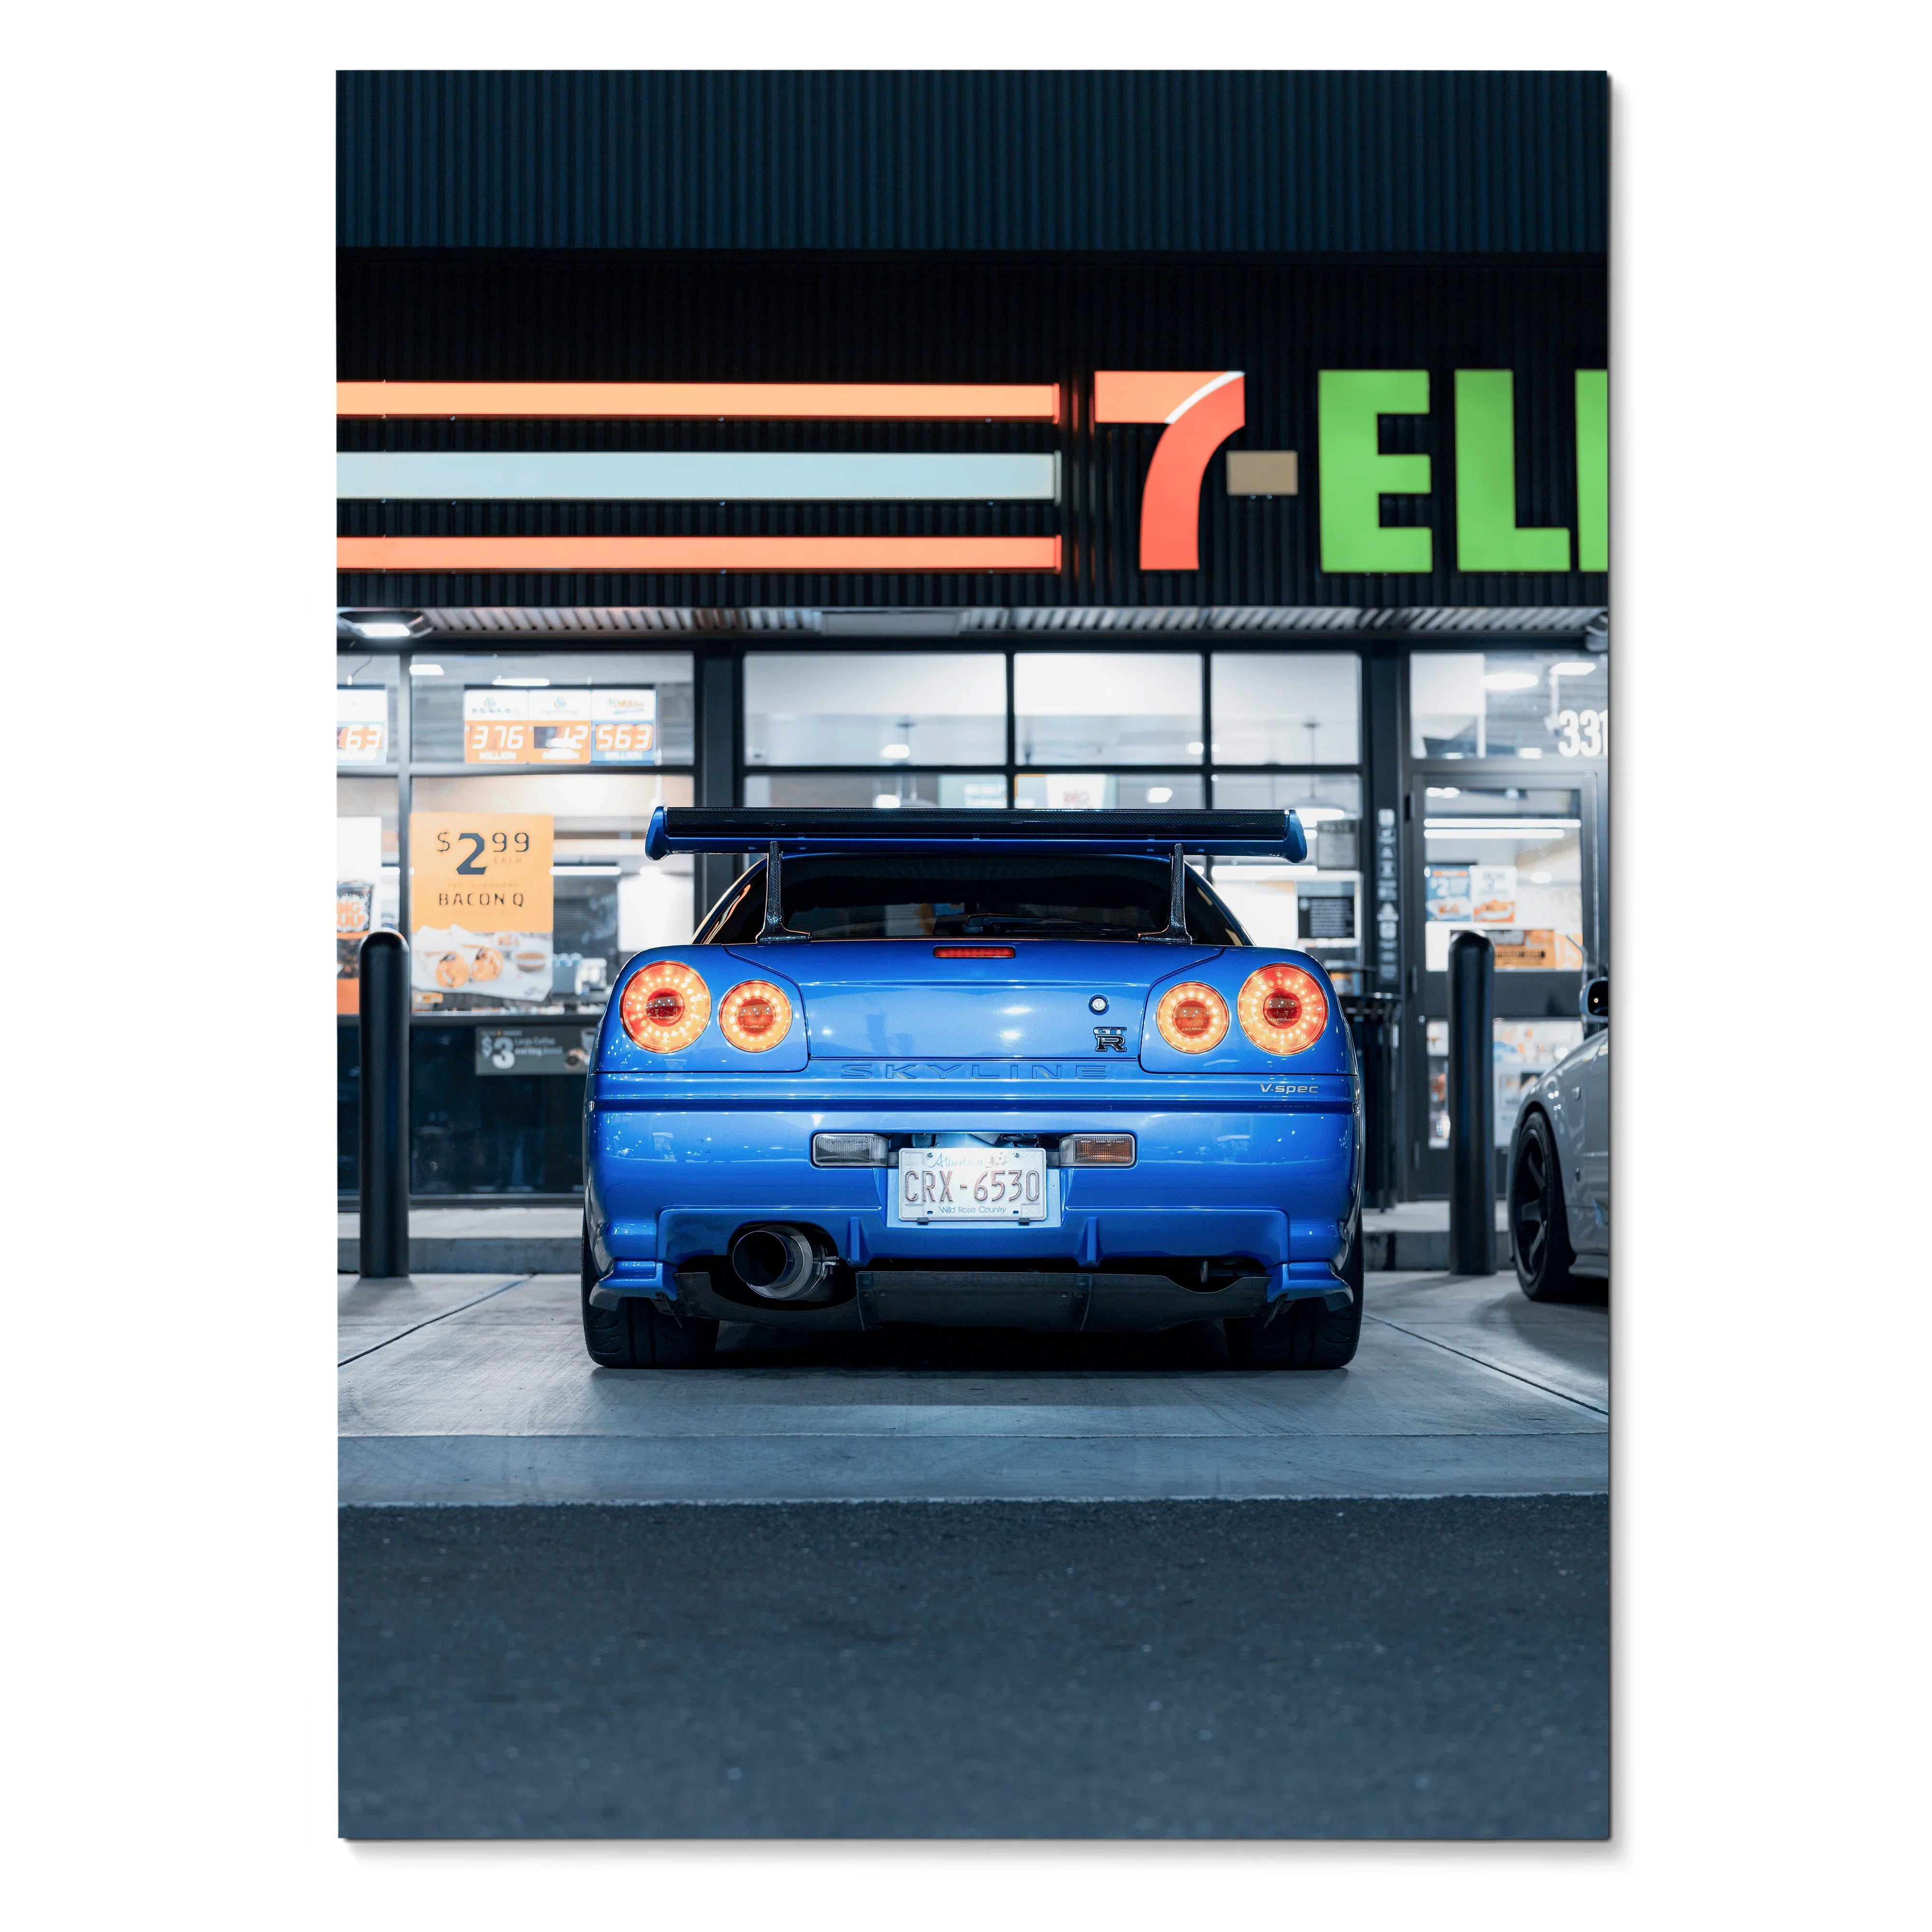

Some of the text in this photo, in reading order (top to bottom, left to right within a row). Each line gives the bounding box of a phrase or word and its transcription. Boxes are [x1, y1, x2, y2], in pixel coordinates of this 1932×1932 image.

[471, 725, 525, 750] 376
[597, 725, 651, 750] 563
[439, 893, 523, 907] BACON Q
[841, 1065, 1106, 1080] SKYLINE
